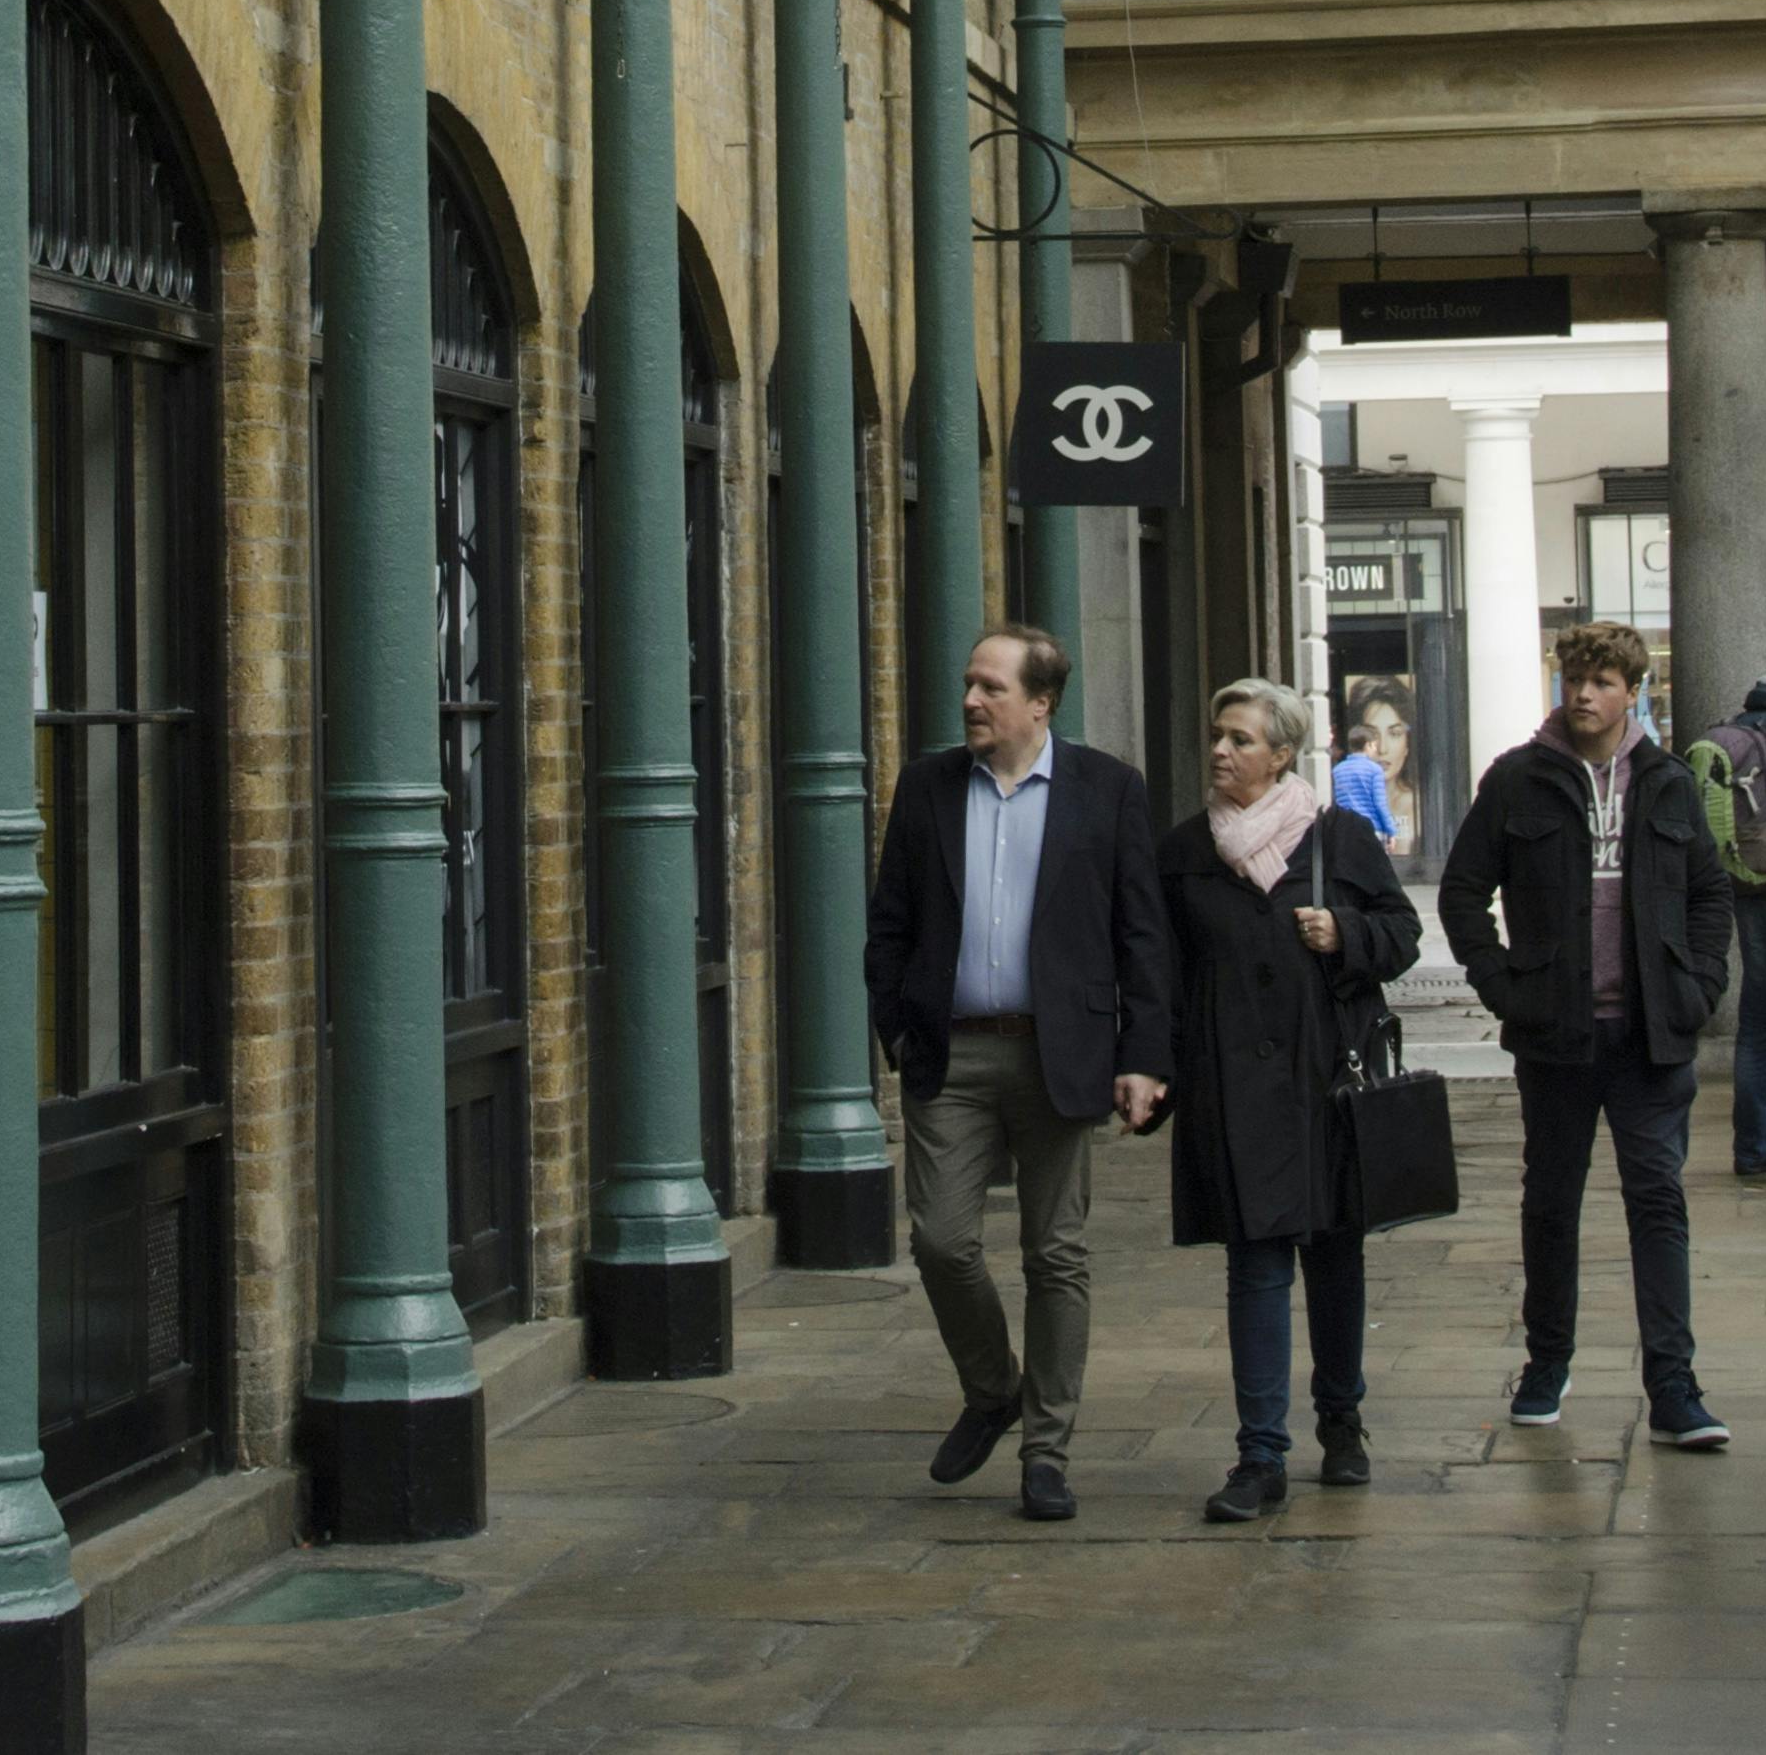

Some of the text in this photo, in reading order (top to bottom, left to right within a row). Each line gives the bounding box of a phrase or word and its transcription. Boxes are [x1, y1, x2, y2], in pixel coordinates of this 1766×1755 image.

[1384, 302, 1482, 321] North Row
[1324, 564, 1384, 591] ROWN
